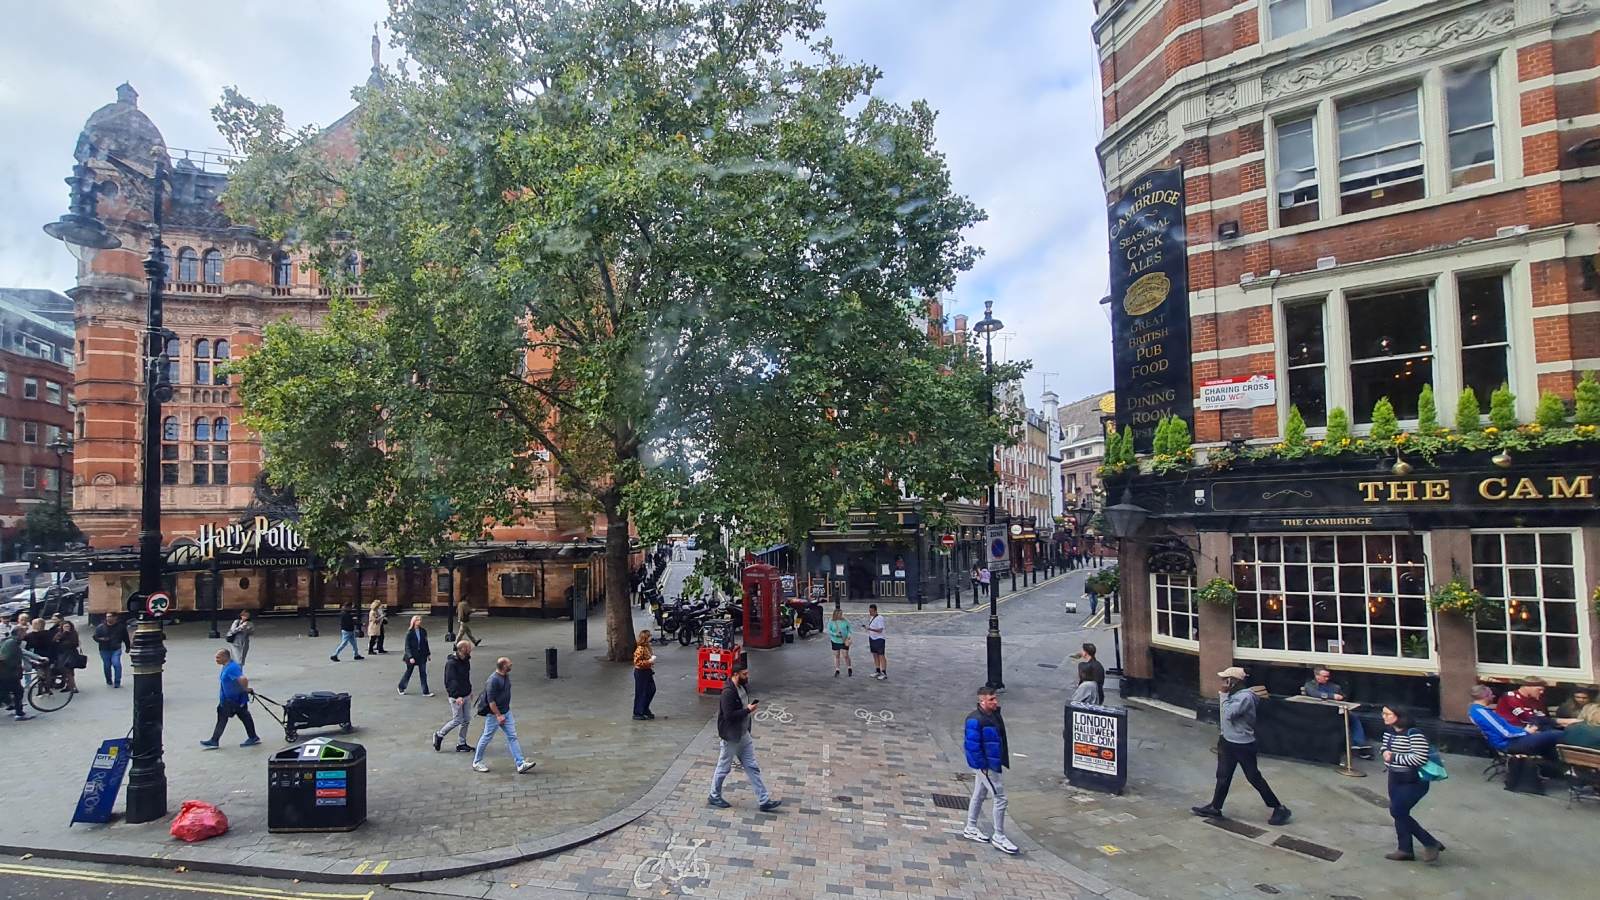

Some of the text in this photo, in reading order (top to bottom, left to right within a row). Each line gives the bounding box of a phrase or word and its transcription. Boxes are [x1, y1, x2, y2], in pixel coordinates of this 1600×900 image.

[1132, 180, 1152, 197] THE
[1110, 190, 1180, 239] CAMBRIDGE
[1119, 217, 1169, 249] SEASONAL
[1127, 234, 1162, 260] CASK
[1129, 251, 1162, 276] ALES
[1130, 314, 1165, 333] GREAT
[1128, 327, 1168, 349] BRITISH
[1136, 344, 1162, 361] PUB
[1131, 359, 1169, 379] FOOD
[1204, 383, 1269, 396] CHARING CROSS
[1205, 395, 1226, 403] ROAD
[1127, 389, 1176, 411] DINING
[1132, 407, 1172, 425] ROOM
[1358, 475, 1600, 502] THE CAM
[1305, 517, 1373, 526] CAMBRIDGE
[196, 522, 252, 559] Harry
[243, 558, 277, 566] CURSED
[279, 557, 307, 566] CHILD
[1075, 713, 1114, 729] LONDON
[1074, 724, 1115, 738] HALLOWEEN
